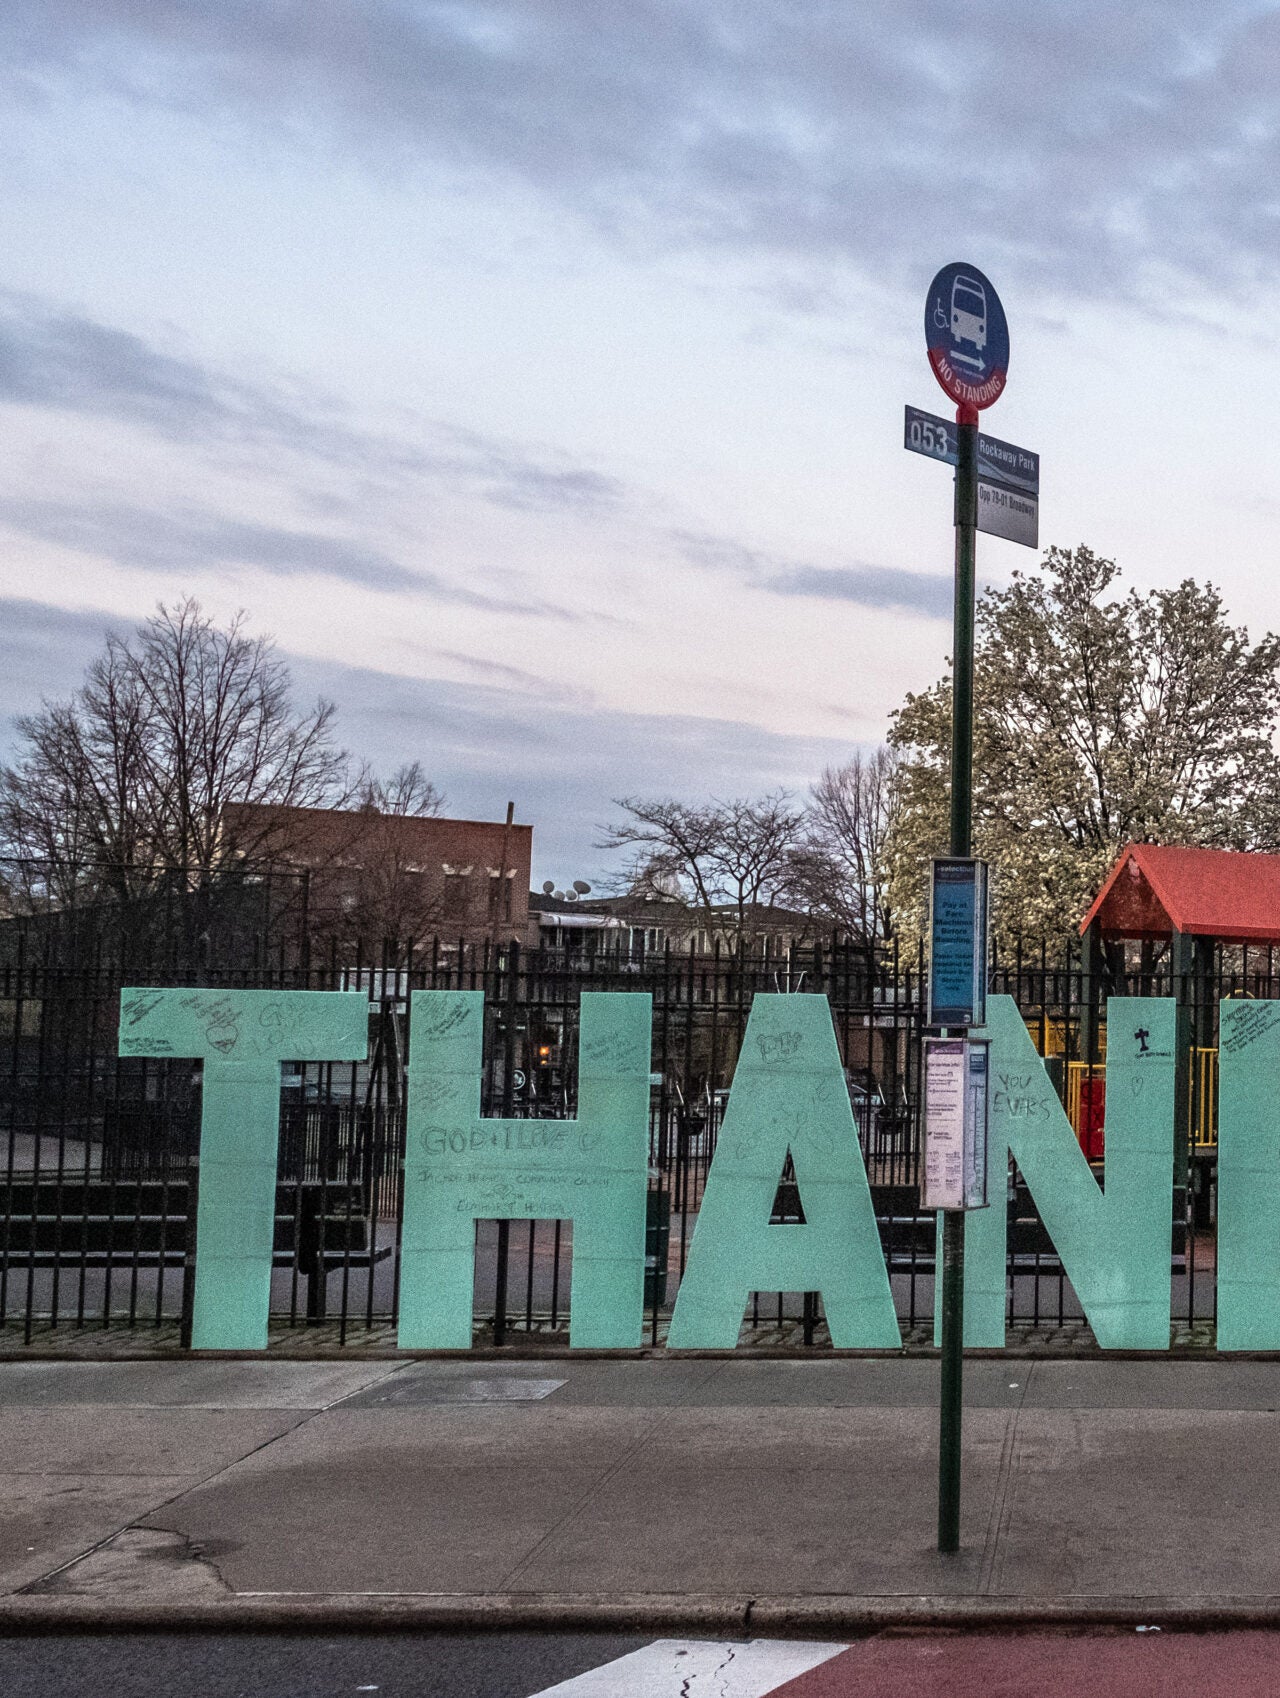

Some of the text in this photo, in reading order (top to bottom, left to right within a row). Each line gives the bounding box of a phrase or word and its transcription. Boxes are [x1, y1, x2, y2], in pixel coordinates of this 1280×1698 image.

[938, 358, 953, 381] NO
[954, 376, 1002, 402] STANDING
[911, 421, 948, 457] Q53
[980, 439, 1035, 471] Rockaway Park
[1009, 496, 1035, 519] Broadway
[998, 1073, 1032, 1091] YOU
